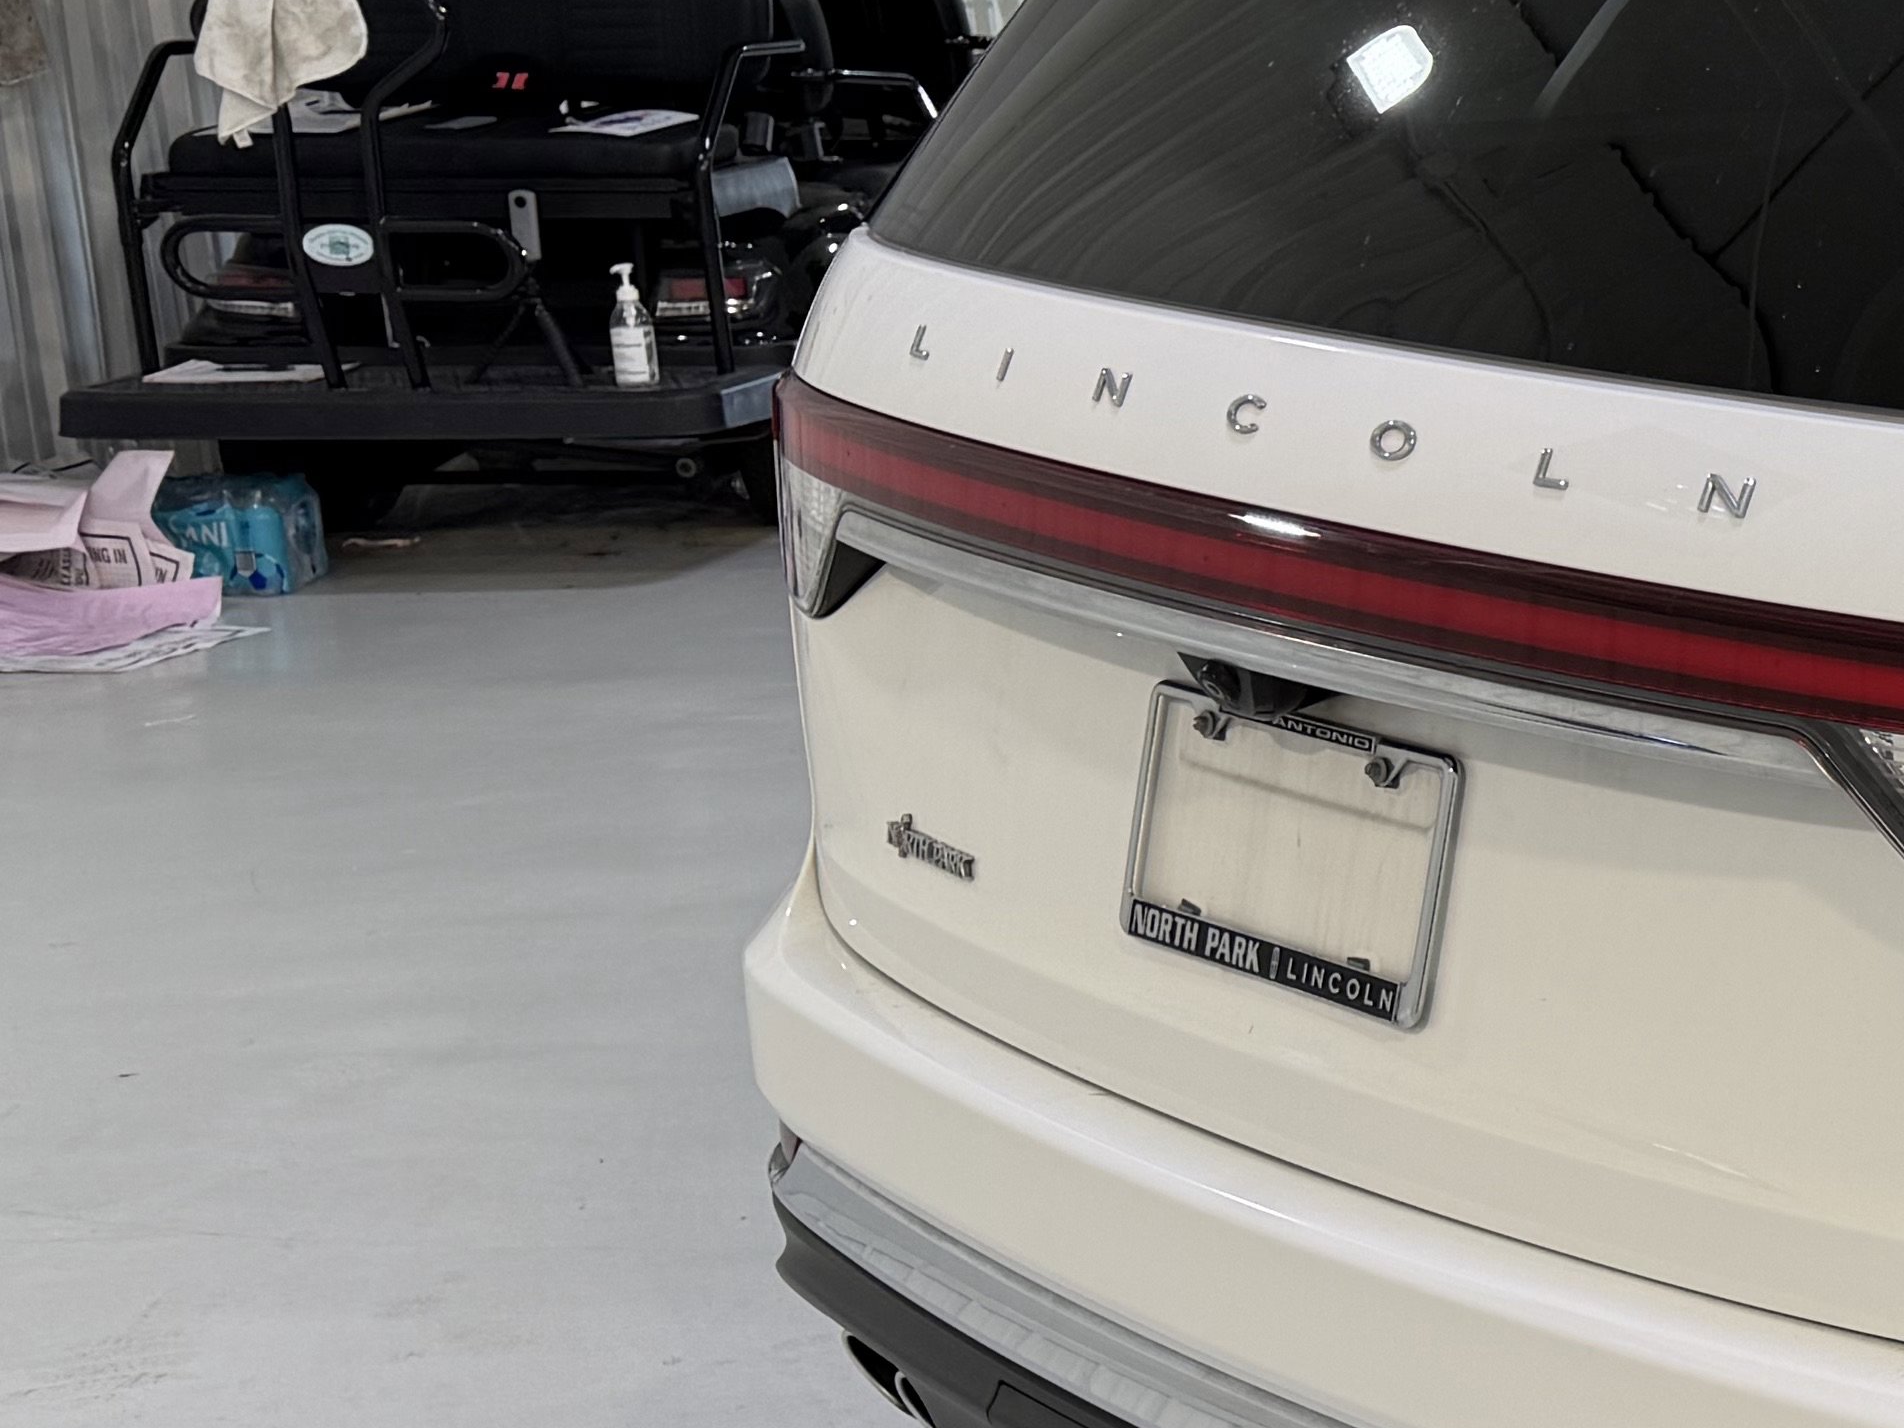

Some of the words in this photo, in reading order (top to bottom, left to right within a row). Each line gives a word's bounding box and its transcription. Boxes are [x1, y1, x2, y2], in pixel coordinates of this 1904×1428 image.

[908, 323, 1759, 521] LINCOLN
[1271, 716, 1371, 750] ANTONIO
[1131, 903, 1200, 952] NORTH
[1204, 926, 1260, 974] PARK
[1286, 957, 1393, 1012] LINCOLN
